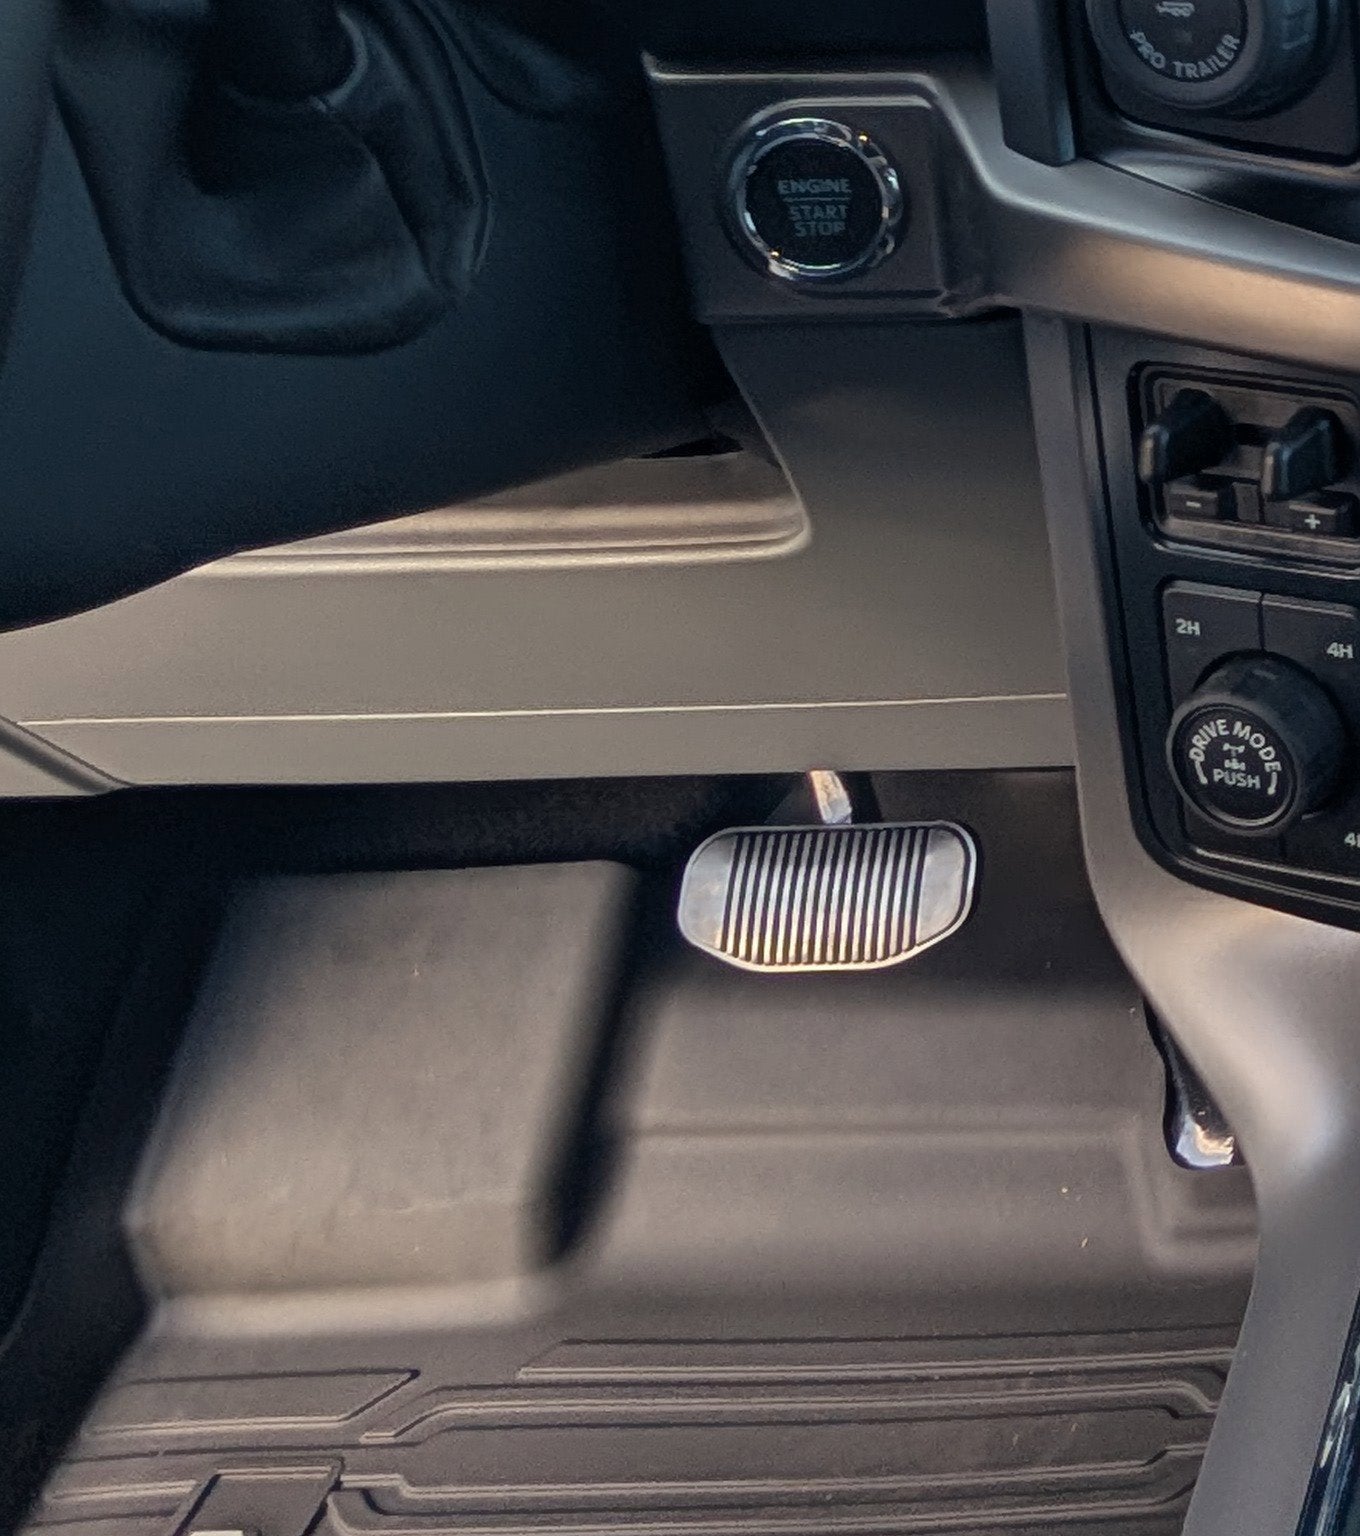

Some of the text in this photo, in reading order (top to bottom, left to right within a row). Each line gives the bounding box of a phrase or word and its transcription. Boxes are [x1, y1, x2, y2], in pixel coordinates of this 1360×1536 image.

[1129, 27, 1241, 79] PRO TRAILER
[777, 177, 852, 195] ENGINE
[789, 204, 848, 222] START
[794, 220, 846, 237] STOP
[1175, 618, 1201, 636] 2H
[1326, 642, 1354, 659] 4H
[1189, 717, 1282, 774] DRIVE MODE
[1212, 766, 1261, 789] PUSH
